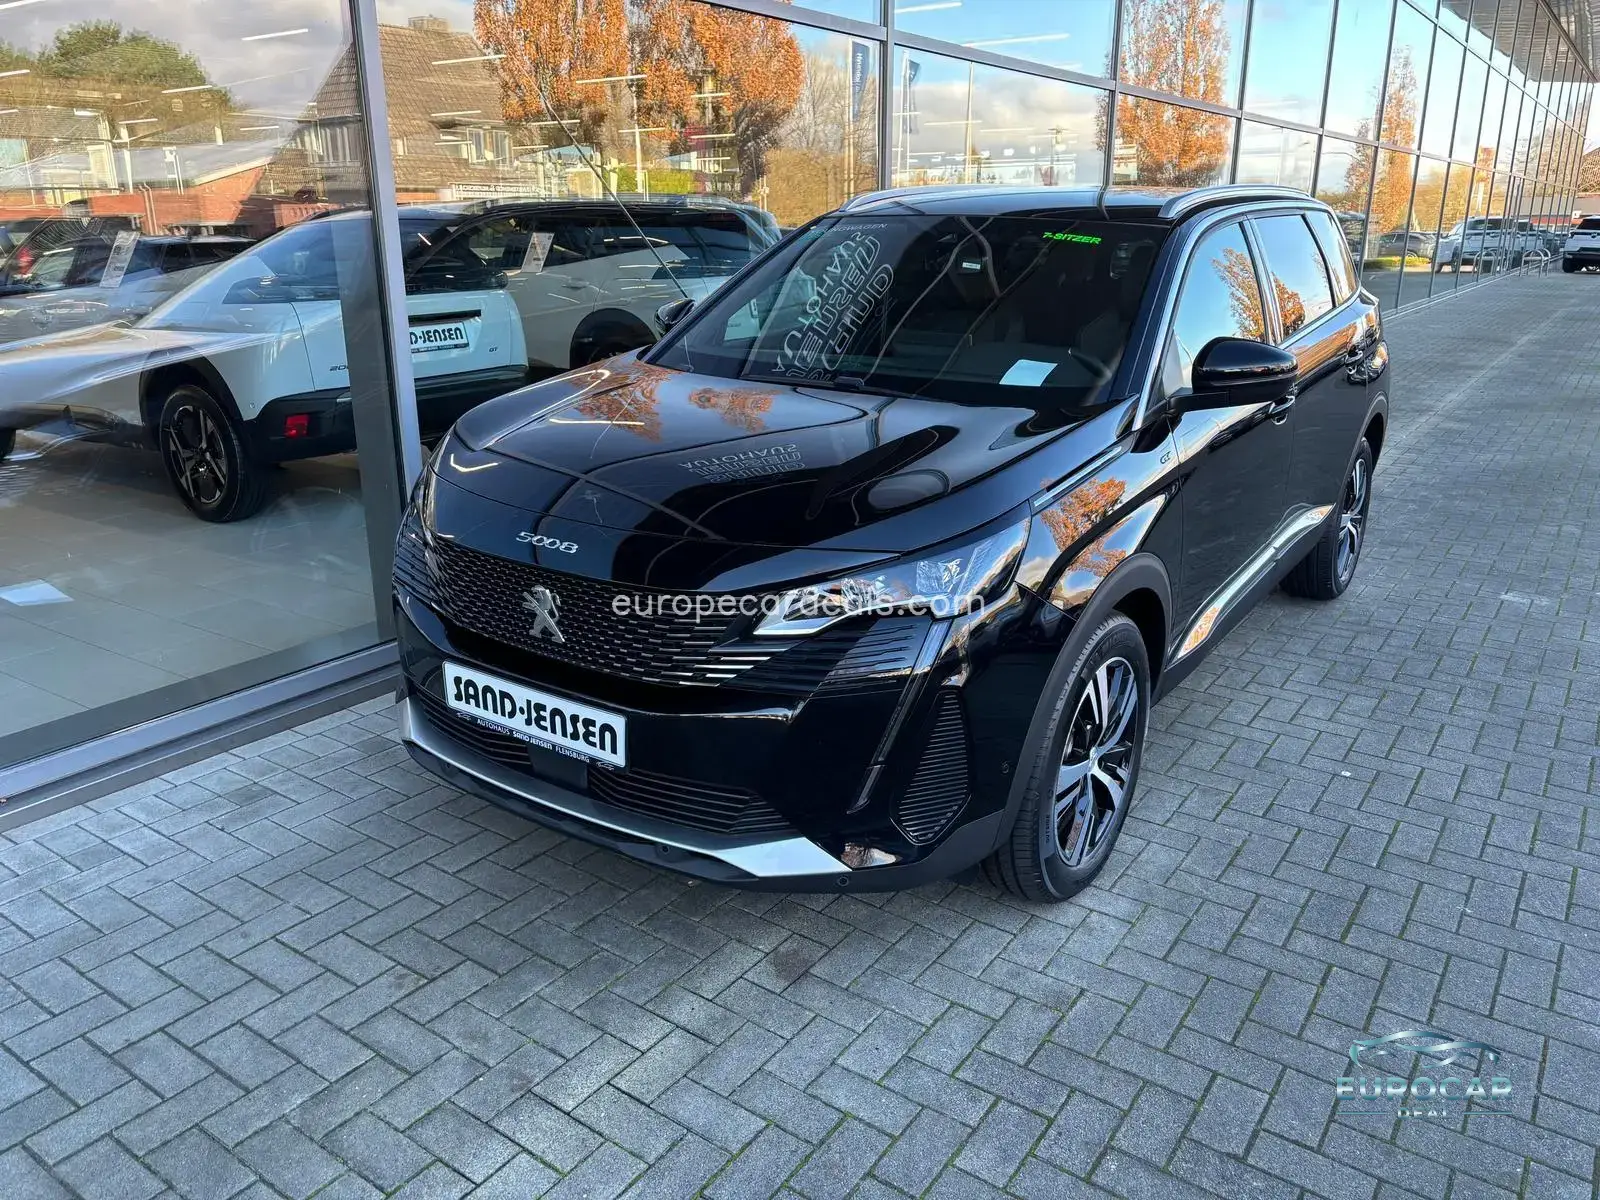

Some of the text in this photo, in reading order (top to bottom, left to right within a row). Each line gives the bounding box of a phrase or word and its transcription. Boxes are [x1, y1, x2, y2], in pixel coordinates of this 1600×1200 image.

[1043, 231, 1102, 244] 7-SITZER
[1160, 450, 1171, 464] GT
[515, 531, 579, 554] 5008
[476, 718, 590, 763] AUTOHAUS SAND JENSEN FLENSBURG
